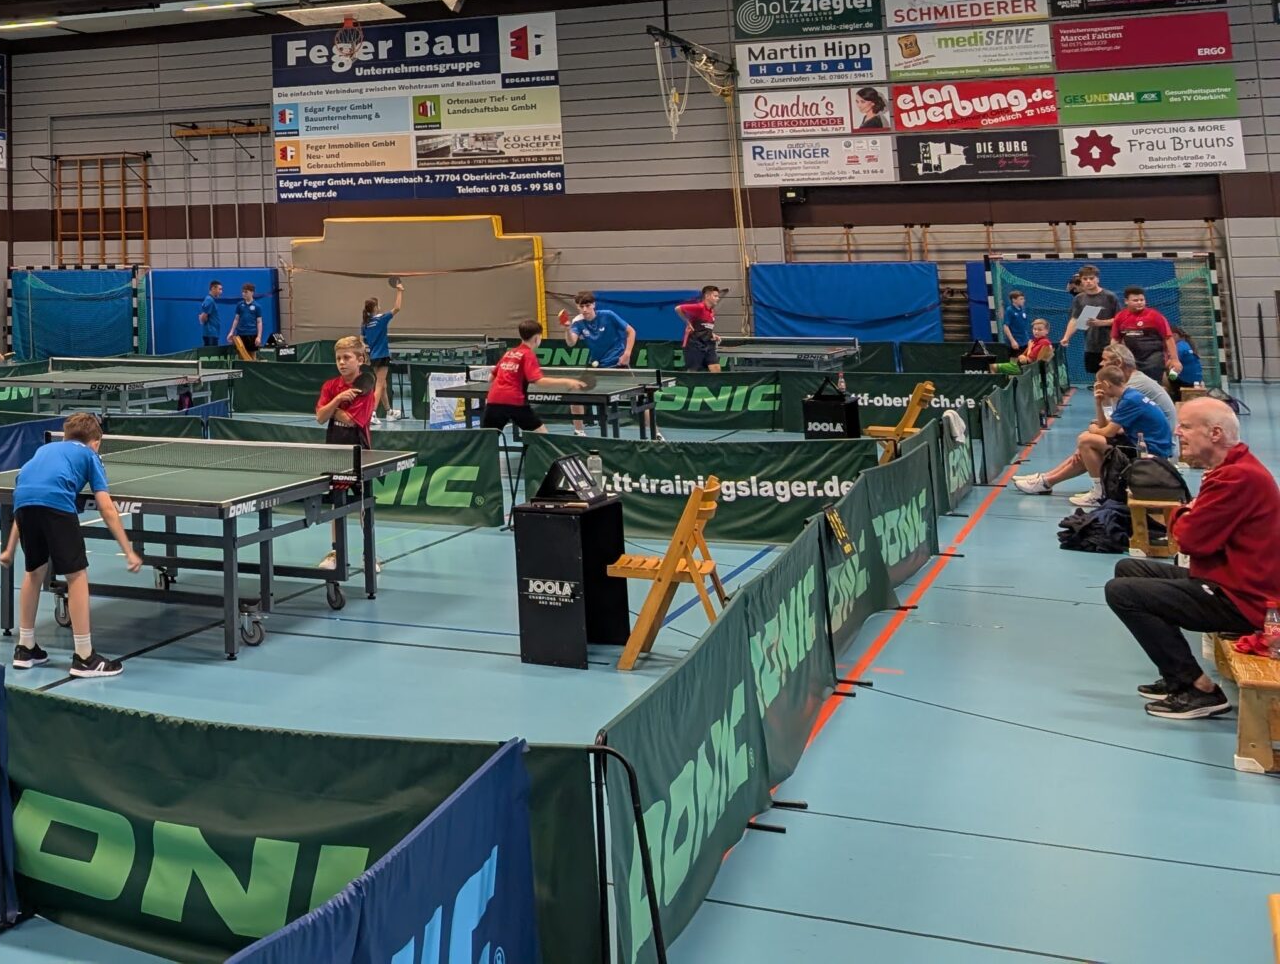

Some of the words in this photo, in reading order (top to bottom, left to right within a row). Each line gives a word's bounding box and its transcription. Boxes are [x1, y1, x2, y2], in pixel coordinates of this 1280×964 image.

[802, 22, 874, 32] www.holz-ziegler.de
[937, 28, 1034, 49] mediSERVE
[1060, 34, 1090, 42] Marcel
[286, 39, 393, 73] Feger
[405, 30, 480, 57] Bau
[748, 43, 817, 62] Martin
[824, 41, 871, 59] Hipp
[1197, 46, 1226, 56] ERGO
[355, 61, 481, 76] Unternehmensgruppe
[759, 61, 861, 74] Holzbau
[532, 75, 555, 83] FEGER
[290, 89, 324, 98] einfachste
[325, 87, 364, 96] Verbindung
[365, 85, 397, 93] zwischen
[398, 83, 439, 91] Wohntraum
[456, 79, 496, 87] Realisation
[1164, 87, 1232, 96] Gesundheitspartner
[446, 96, 487, 105] Ortenauer
[896, 85, 958, 110] elan
[1064, 91, 1135, 104] GESUNDNAH
[304, 106, 325, 115] Edgar
[327, 104, 348, 113] Feger
[349, 103, 373, 111] GmbH
[447, 105, 509, 115] Landschaftsbau
[754, 95, 834, 119] Sandra's
[900, 88, 1054, 128] werbung.de
[1036, 105, 1057, 115] 1555
[304, 114, 373, 123] Bauunternehmung
[745, 118, 843, 129] FRISIERKOMMODE
[980, 113, 1022, 126] Oberkirch
[305, 123, 339, 132] Zimmerei
[1132, 126, 1186, 136] UPCYCLING
[1198, 124, 1226, 132] MORE
[503, 134, 561, 143] KÜCHEN
[306, 143, 326, 151] Feger
[328, 141, 370, 150] Immobilien
[372, 140, 396, 148] GmbH
[504, 141, 560, 150] CONCEPTE
[976, 142, 993, 153] DIE
[998, 141, 1028, 153] BURG
[1127, 139, 1166, 153] Frau
[1170, 136, 1234, 151] Bruuns
[1148, 154, 1205, 162] Bahnhofstraße
[307, 160, 386, 170] Gebrauchtimmobilien
[279, 179, 302, 189] Edgar
[303, 178, 325, 188] Feger
[327, 178, 356, 186] GmbH,
[357, 177, 372, 185] Am
[373, 176, 423, 184] Wiesenbach
[435, 174, 461, 182] 77704
[462, 171, 562, 181] Oberkirch-Zusenhofen
[280, 189, 338, 200] www.feger.de
[456, 185, 489, 194] Telefon:
[807, 422, 843, 433] JOOLA
[84, 500, 142, 514] DNIC
[228, 500, 257, 518] DONIC
[528, 580, 572, 596] JOOLA
